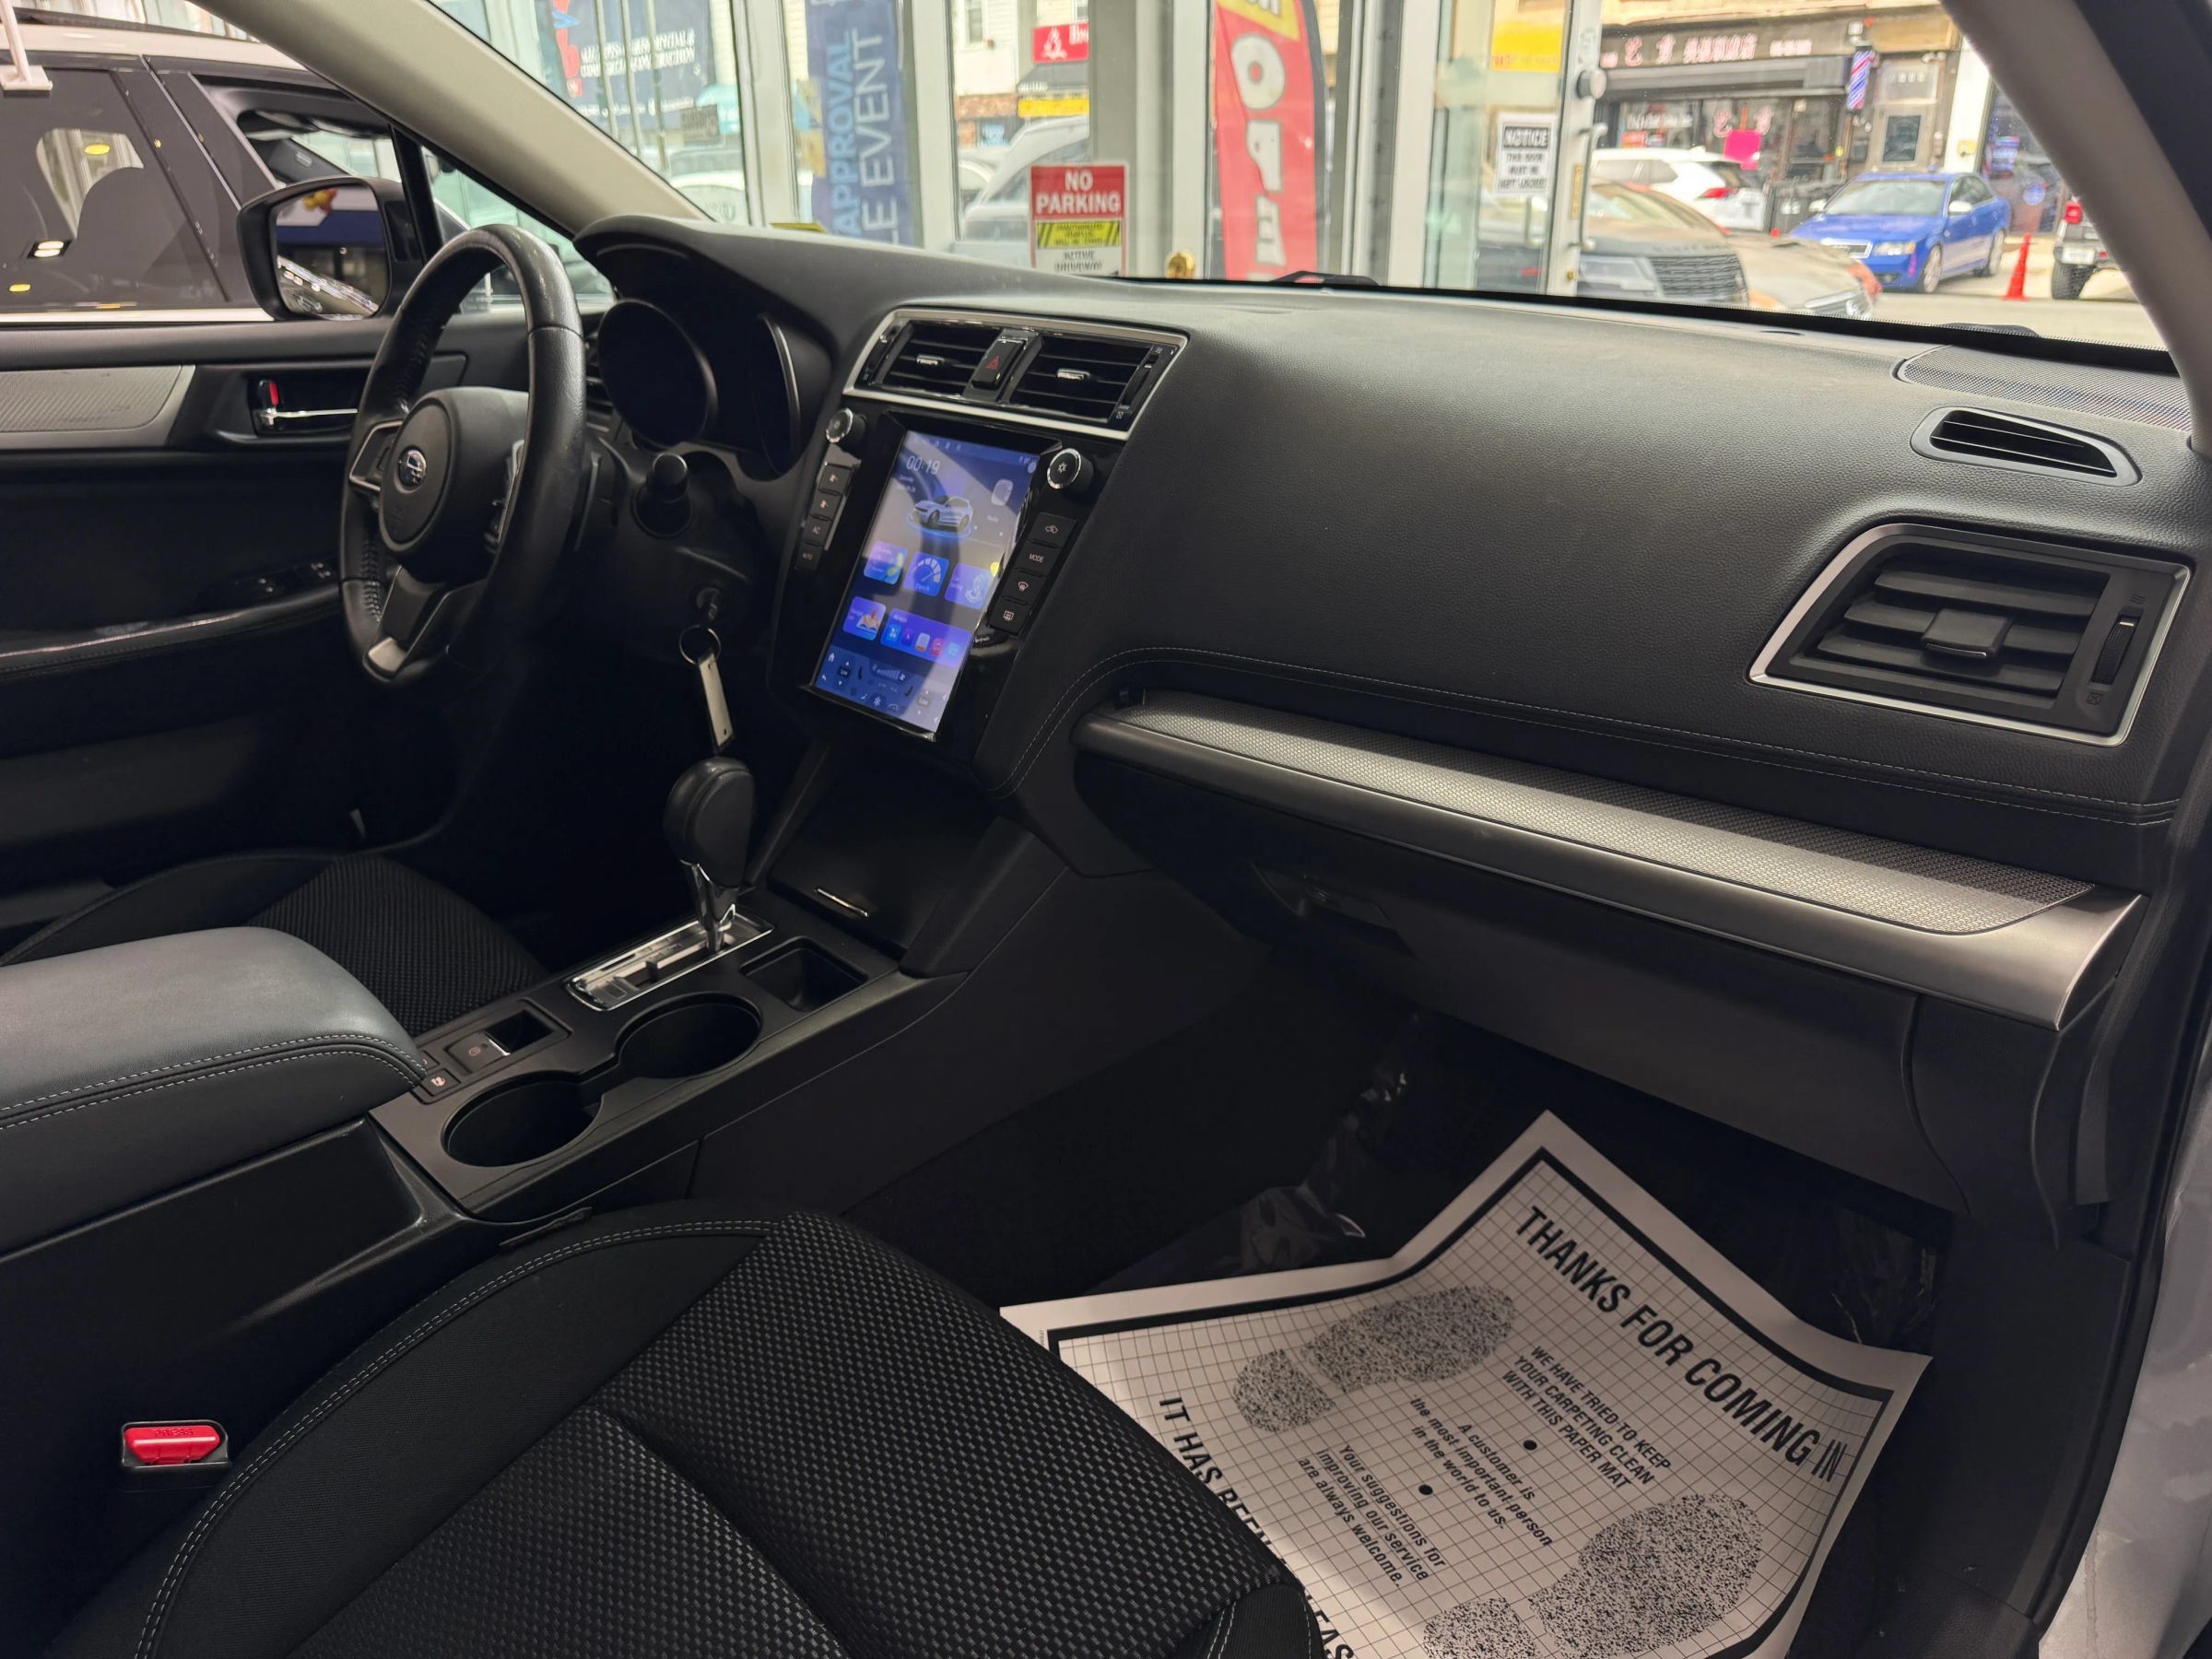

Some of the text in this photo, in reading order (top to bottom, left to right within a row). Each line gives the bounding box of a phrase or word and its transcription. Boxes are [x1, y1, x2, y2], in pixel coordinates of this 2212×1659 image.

[826, 29, 863, 237] APPROVAL
[851, 28, 896, 187] EVENT
[1230, 33, 1288, 281] OPE
[1035, 192, 1121, 214] PARKING
[1065, 170, 1094, 192] NO
[1029, 553, 1045, 563] MODE
[1516, 1206, 1847, 1482] THANKS FOR COMING IN
[154, 1429, 194, 1438] PRESS
[1159, 1397, 1191, 1421] IT
[1173, 1431, 1223, 1484] HAS
[1458, 1424, 1535, 1500] A customer is
[1502, 1370, 1631, 1488] WITH THIS PAPER MAT
[1514, 1356, 1654, 1484] YOUR CARPETING CLEAN
[1531, 1346, 1671, 1469] WE HAVE TRIED TO KEEP
[1299, 1458, 1403, 1587] are always welcome.
[1316, 1449, 1430, 1581] improving our service
[1339, 1445, 1446, 1568] Your suggestions for
[1410, 1398, 1554, 1547] the most important person
[1412, 1426, 1507, 1529] in the world to us.
